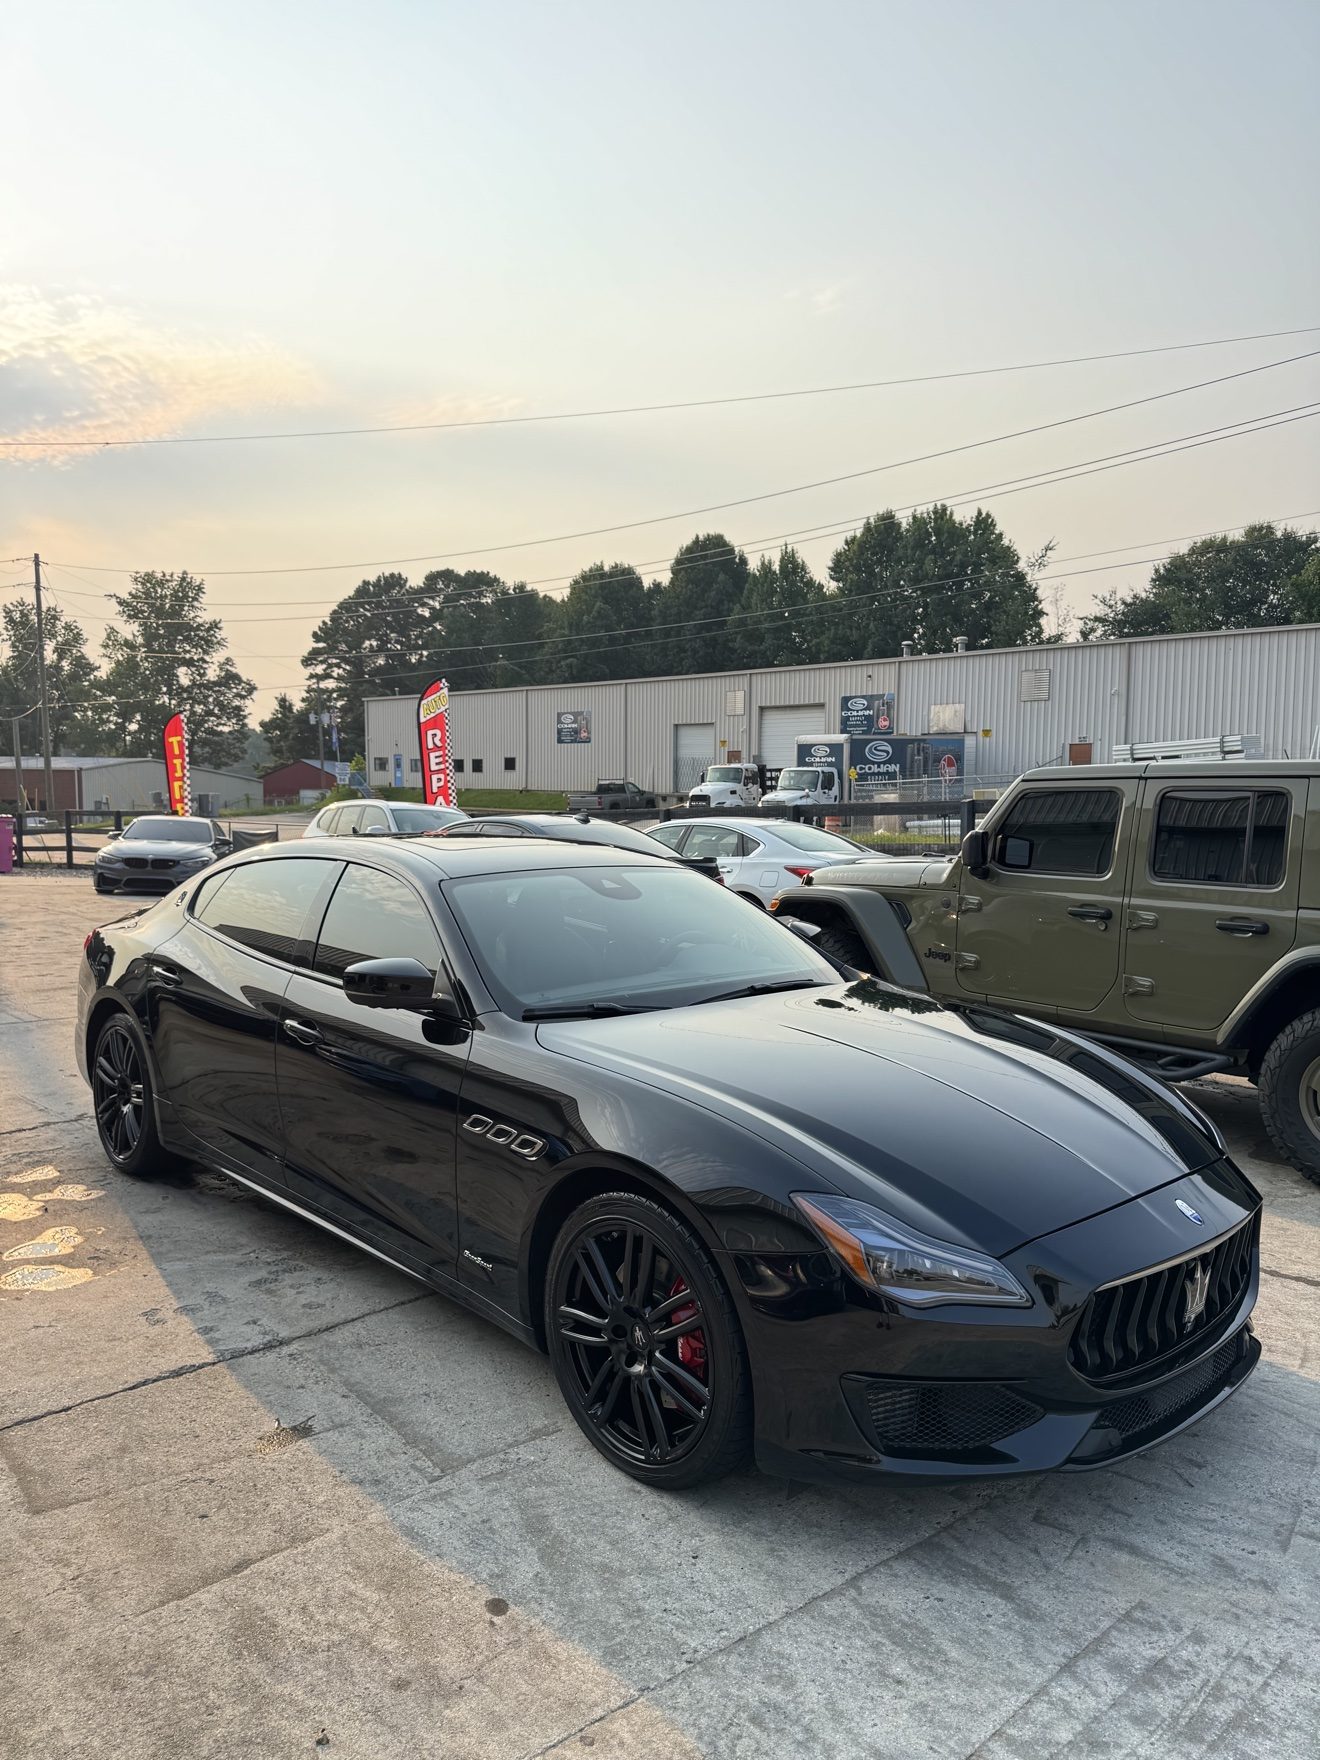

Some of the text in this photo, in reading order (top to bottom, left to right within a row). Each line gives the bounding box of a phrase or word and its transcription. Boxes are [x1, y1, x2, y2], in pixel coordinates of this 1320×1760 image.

[422, 692, 448, 718] AUTO
[856, 764, 900, 773] COWAN
[923, 947, 952, 963] Jeep
